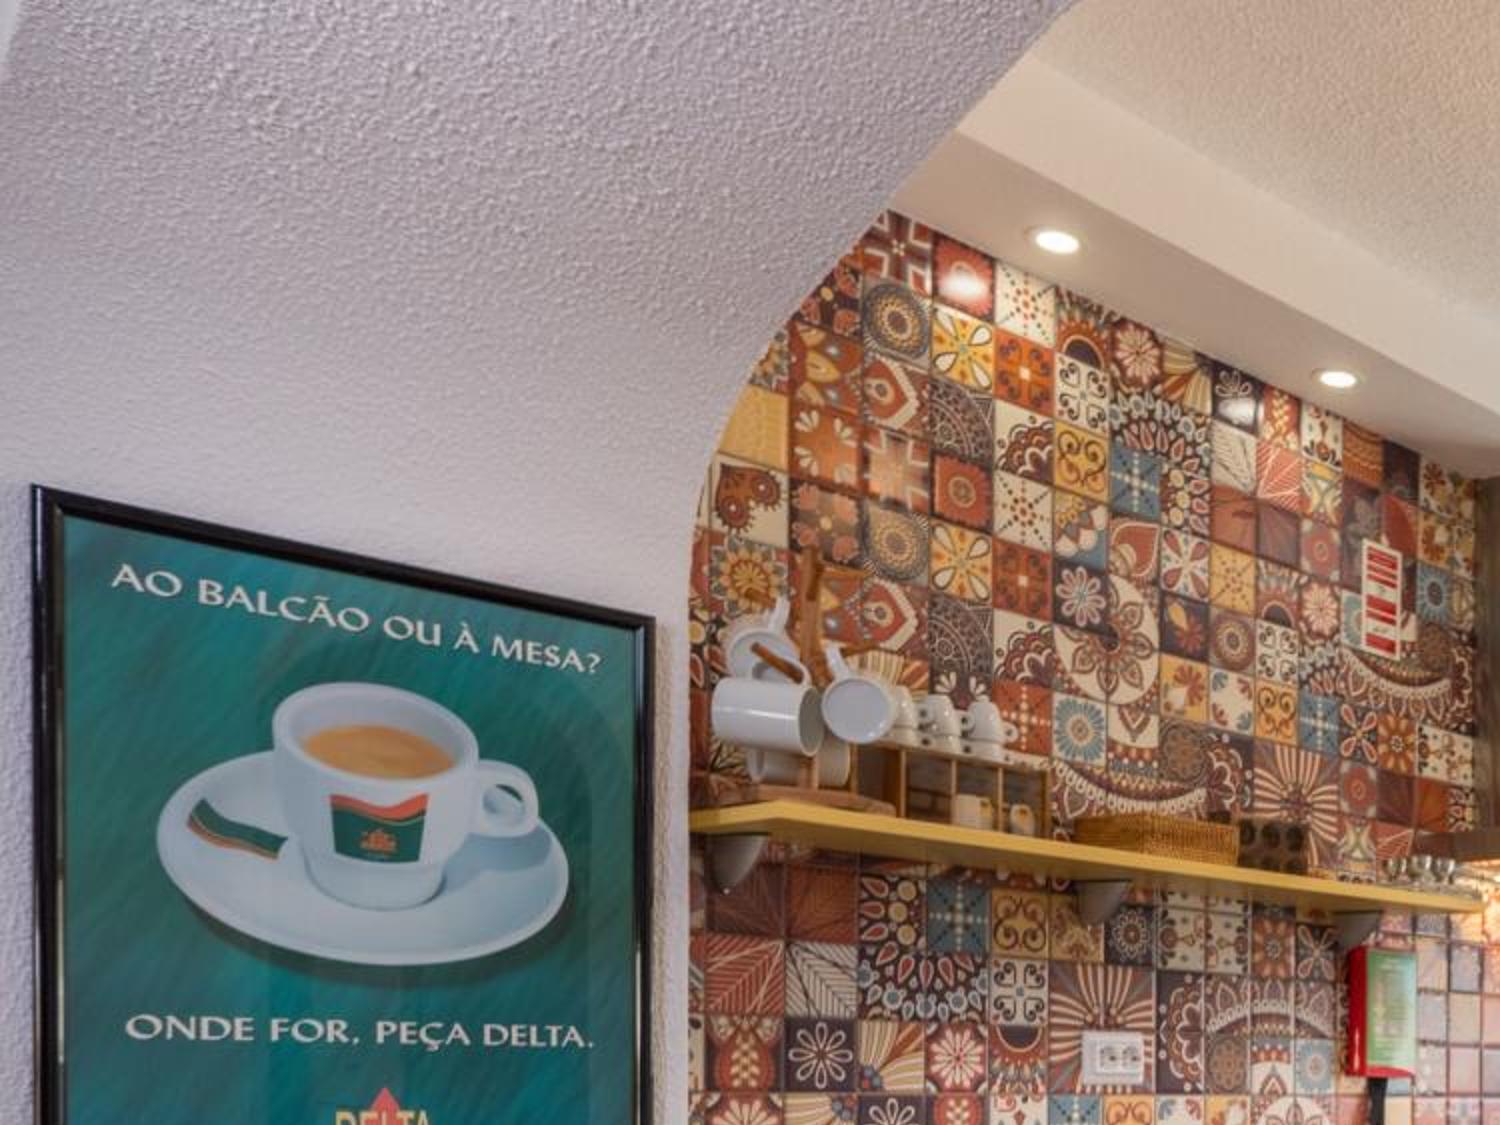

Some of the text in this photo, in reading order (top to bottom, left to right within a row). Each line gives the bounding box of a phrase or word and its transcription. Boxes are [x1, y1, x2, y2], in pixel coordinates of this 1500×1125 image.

[111, 563, 601, 673] AO BALCÃO OU À MESA?
[125, 1013, 254, 1041] ONDE
[375, 1020, 472, 1051] PEÇA
[482, 1023, 595, 1049] DELTA.
